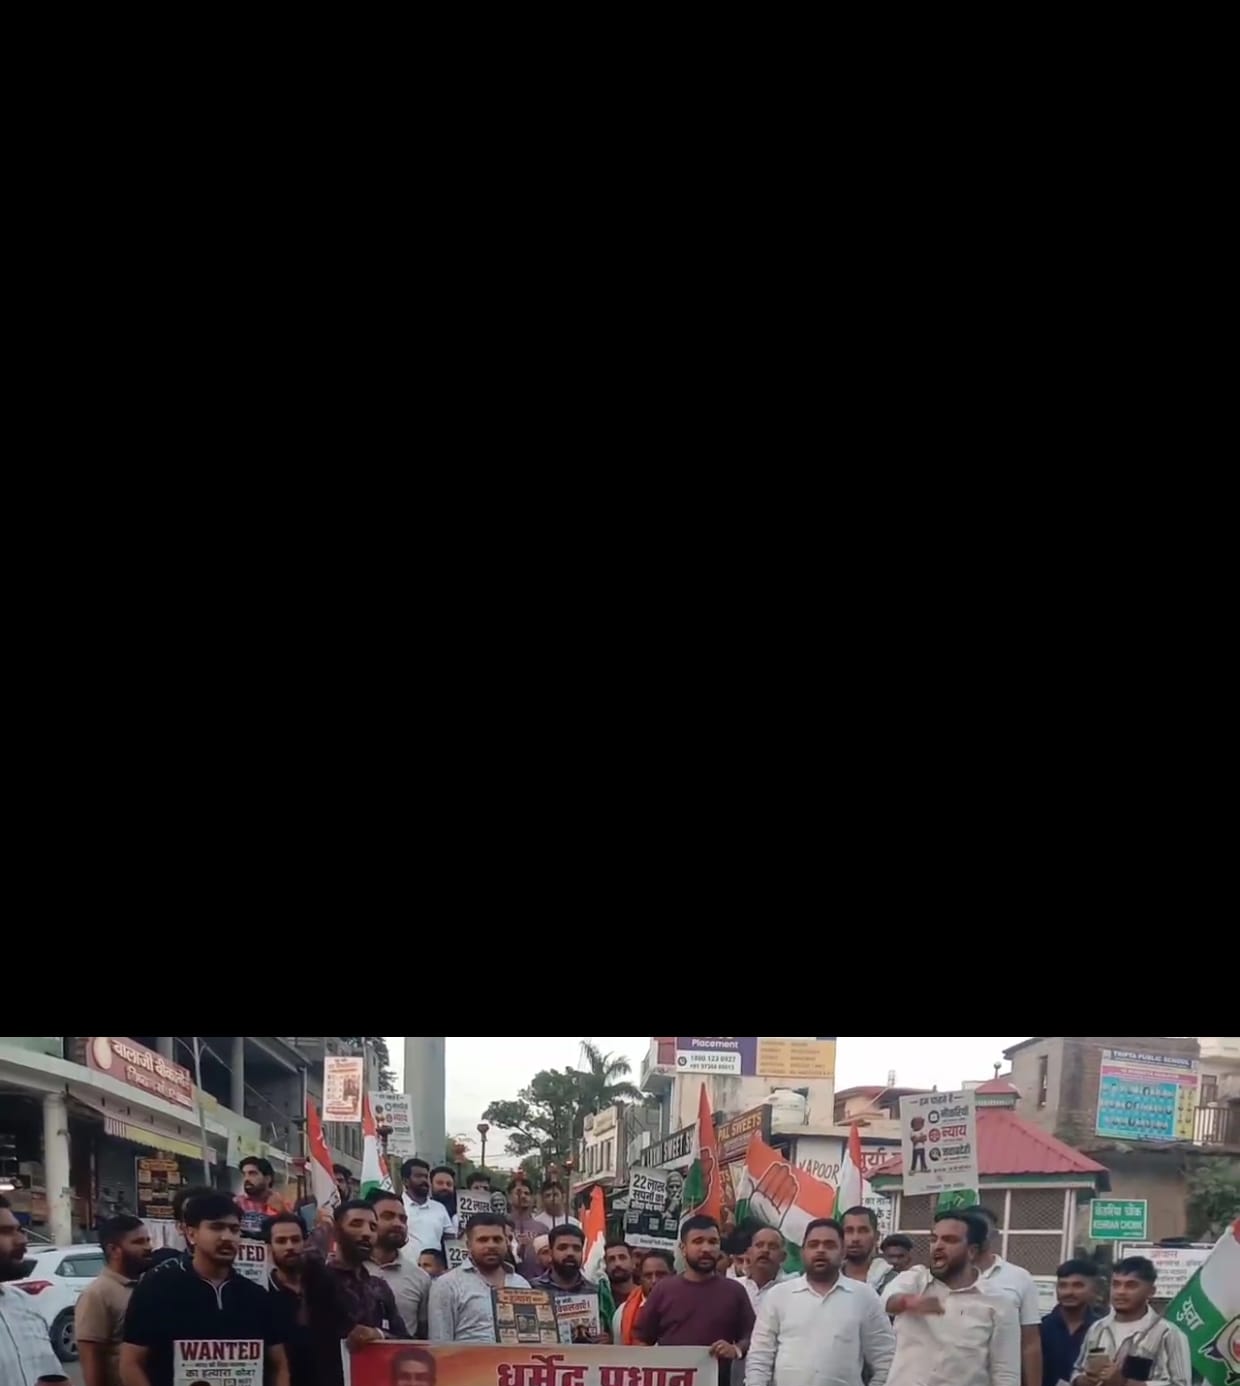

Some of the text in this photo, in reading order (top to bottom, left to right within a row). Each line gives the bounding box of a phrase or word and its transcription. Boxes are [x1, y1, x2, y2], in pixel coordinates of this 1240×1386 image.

[692, 1039, 739, 1049] Placement
[732, 1113, 762, 1137] SWEETS
[941, 1125, 968, 1138] न्याय
[664, 1133, 684, 1162] SWEET
[634, 1173, 665, 1193] 22 लाख
[460, 1197, 472, 1211] 22
[238, 1244, 265, 1262] TED
[449, 1247, 461, 1262] 22
[1176, 1296, 1205, 1331] युवा
[180, 1341, 260, 1360] WANTED
